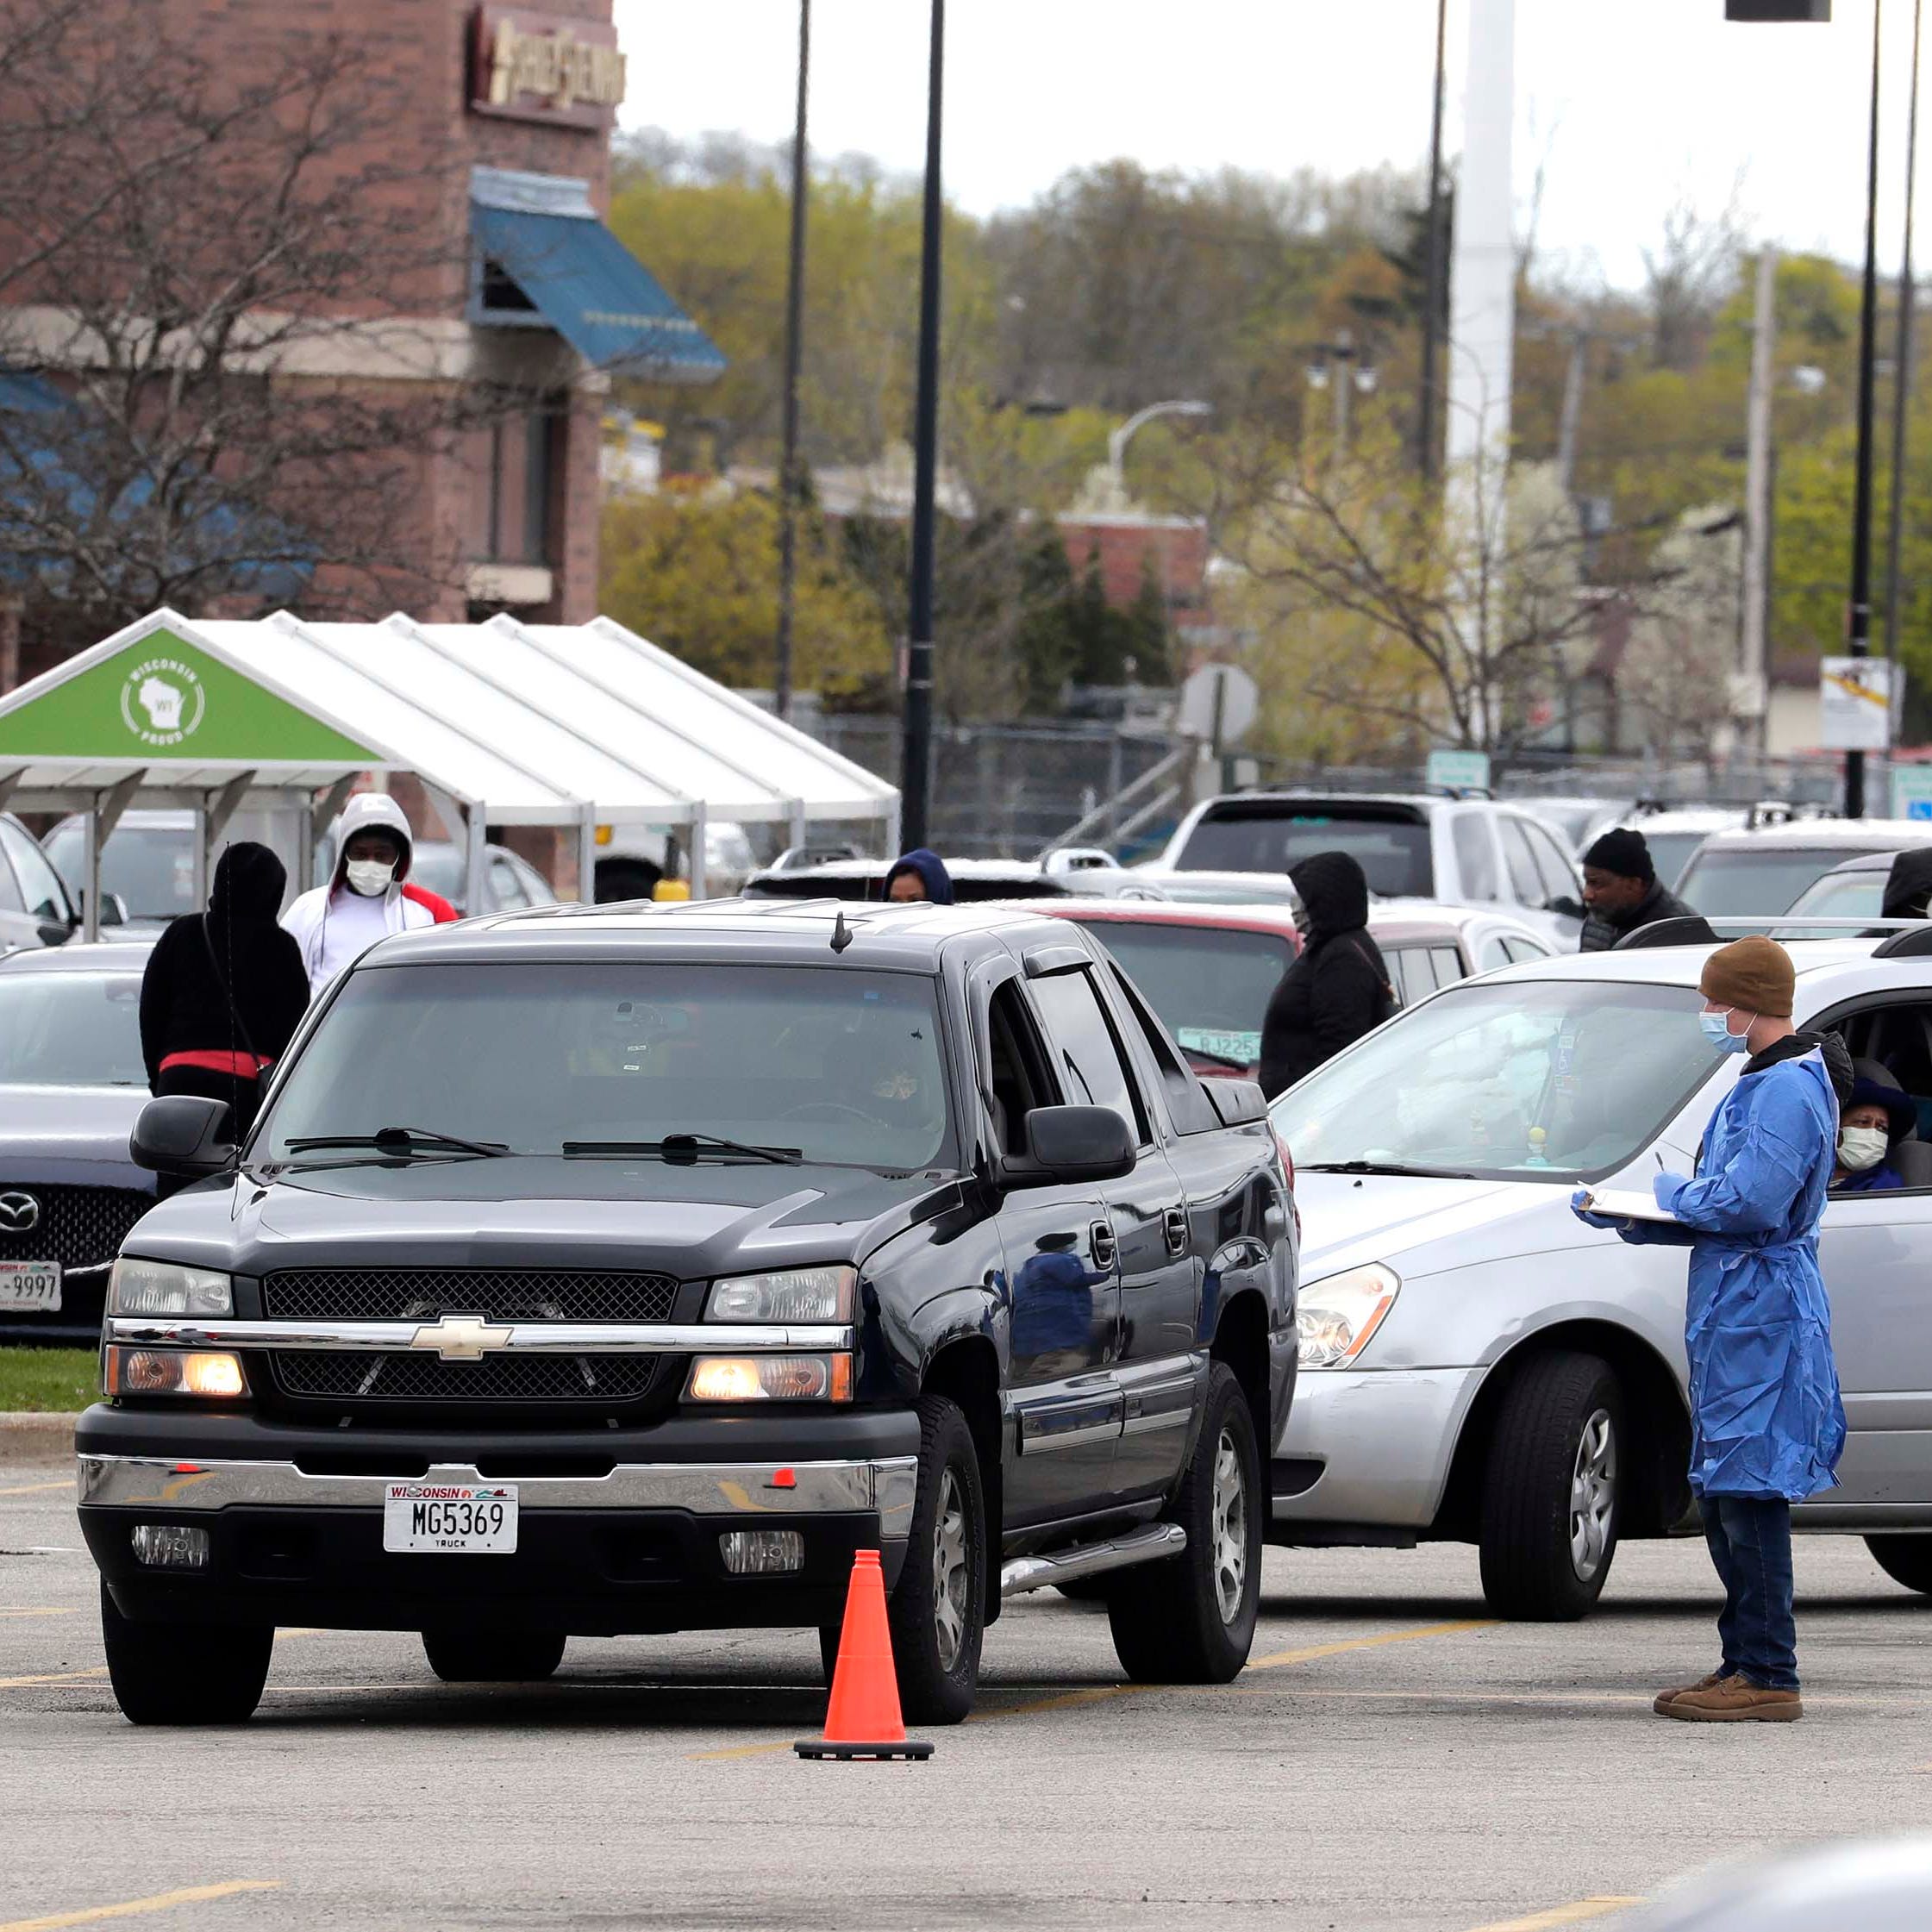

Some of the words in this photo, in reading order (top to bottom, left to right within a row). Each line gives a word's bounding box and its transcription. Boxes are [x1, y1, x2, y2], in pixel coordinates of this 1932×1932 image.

[129, 659, 197, 683] WISCONSIN
[156, 699, 172, 712] WI
[413, 1503, 503, 1535] MG5369
